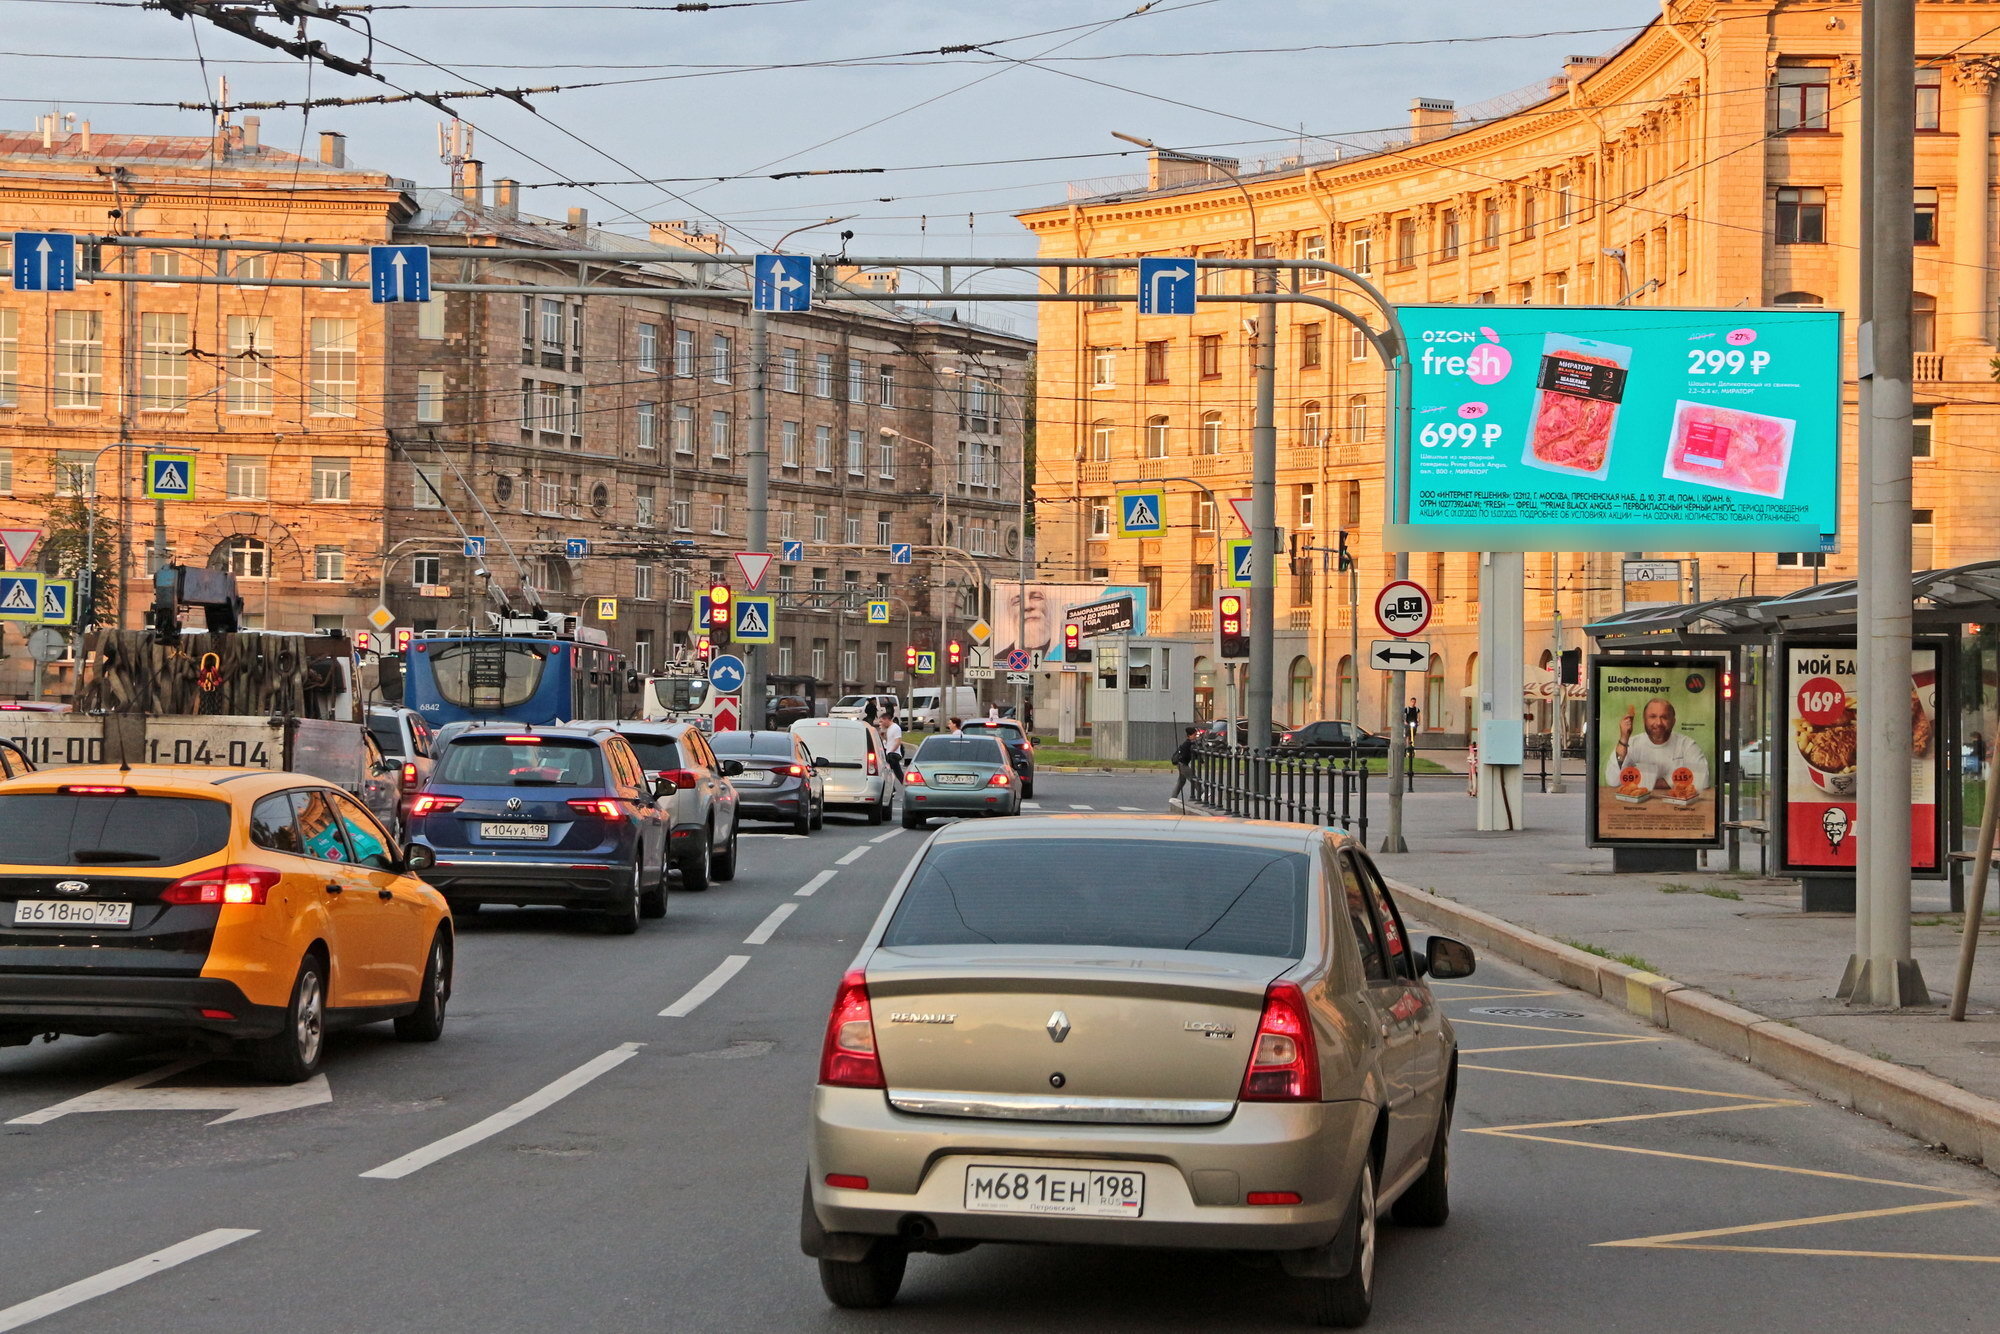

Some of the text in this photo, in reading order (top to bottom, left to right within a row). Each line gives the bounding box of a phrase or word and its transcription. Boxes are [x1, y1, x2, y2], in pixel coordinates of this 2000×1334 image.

[1422, 330, 1476, 343] OZON
[1421, 347, 1501, 376] fresh
[1558, 360, 1594, 372] МИРАТОРГ
[1687, 349, 1771, 375] 299 ₽
[1419, 422, 1503, 448] 699 ₽
[1419, 490, 1436, 500] ООО
[1437, 490, 1473, 500] «ИНТЕРНЕТ
[1571, 492, 1620, 502] ПРЕСНЕНСКАЯ
[1419, 500, 1437, 509] ОГРН
[1567, 502, 1589, 512] BLACK
[1590, 502, 1613, 512] ANGUS
[1622, 503, 1683, 513] ПЕРВОКЛАССНЫЙ
[1737, 504, 1765, 515] ПЕРИОД
[1766, 505, 1809, 514] ПРОВЕДЕНИЯ
[1419, 509, 1443, 519] АКЦИИ
[1479, 510, 1489, 519] ПО
[1519, 510, 1559, 520] ПОДРОБНЕЕ
[1560, 510, 1570, 520] ОБ
[1571, 511, 1608, 520] УСЛОВИЯХ
[1609, 511, 1632, 521] АКЦИИ
[1642, 512, 1653, 521] НА
[1684, 512, 1729, 522] КОЛИЧЕСТВО
[1730, 513, 1755, 522] ТОВАРА
[713, 609, 728, 621] 58
[1068, 602, 1120, 618] ЗАМОРАЖИВАЕМ
[1086, 612, 1097, 621] ДО
[1097, 608, 1119, 618] КОНЦА
[1083, 617, 1101, 626] ГОДА
[1111, 618, 1131, 630] TELE2
[1224, 620, 1238, 633] 58
[1797, 654, 1857, 675] МОЙ БА
[969, 669, 992, 677] СТОП
[1607, 675, 1662, 685] Шеф-повар
[1607, 685, 1671, 693] рекомендует
[419, 703, 440, 711] 6842
[529, 825, 546, 834] 198
[98, 904, 126, 917] 797
[891, 1012, 958, 1024] RENAULT
[1184, 1020, 1236, 1033] LOGAN
[974, 1172, 1134, 1204] М681ЕН 198
[1029, 1203, 1076, 1212] Петровский
[1100, 1197, 1121, 1206] RUS
